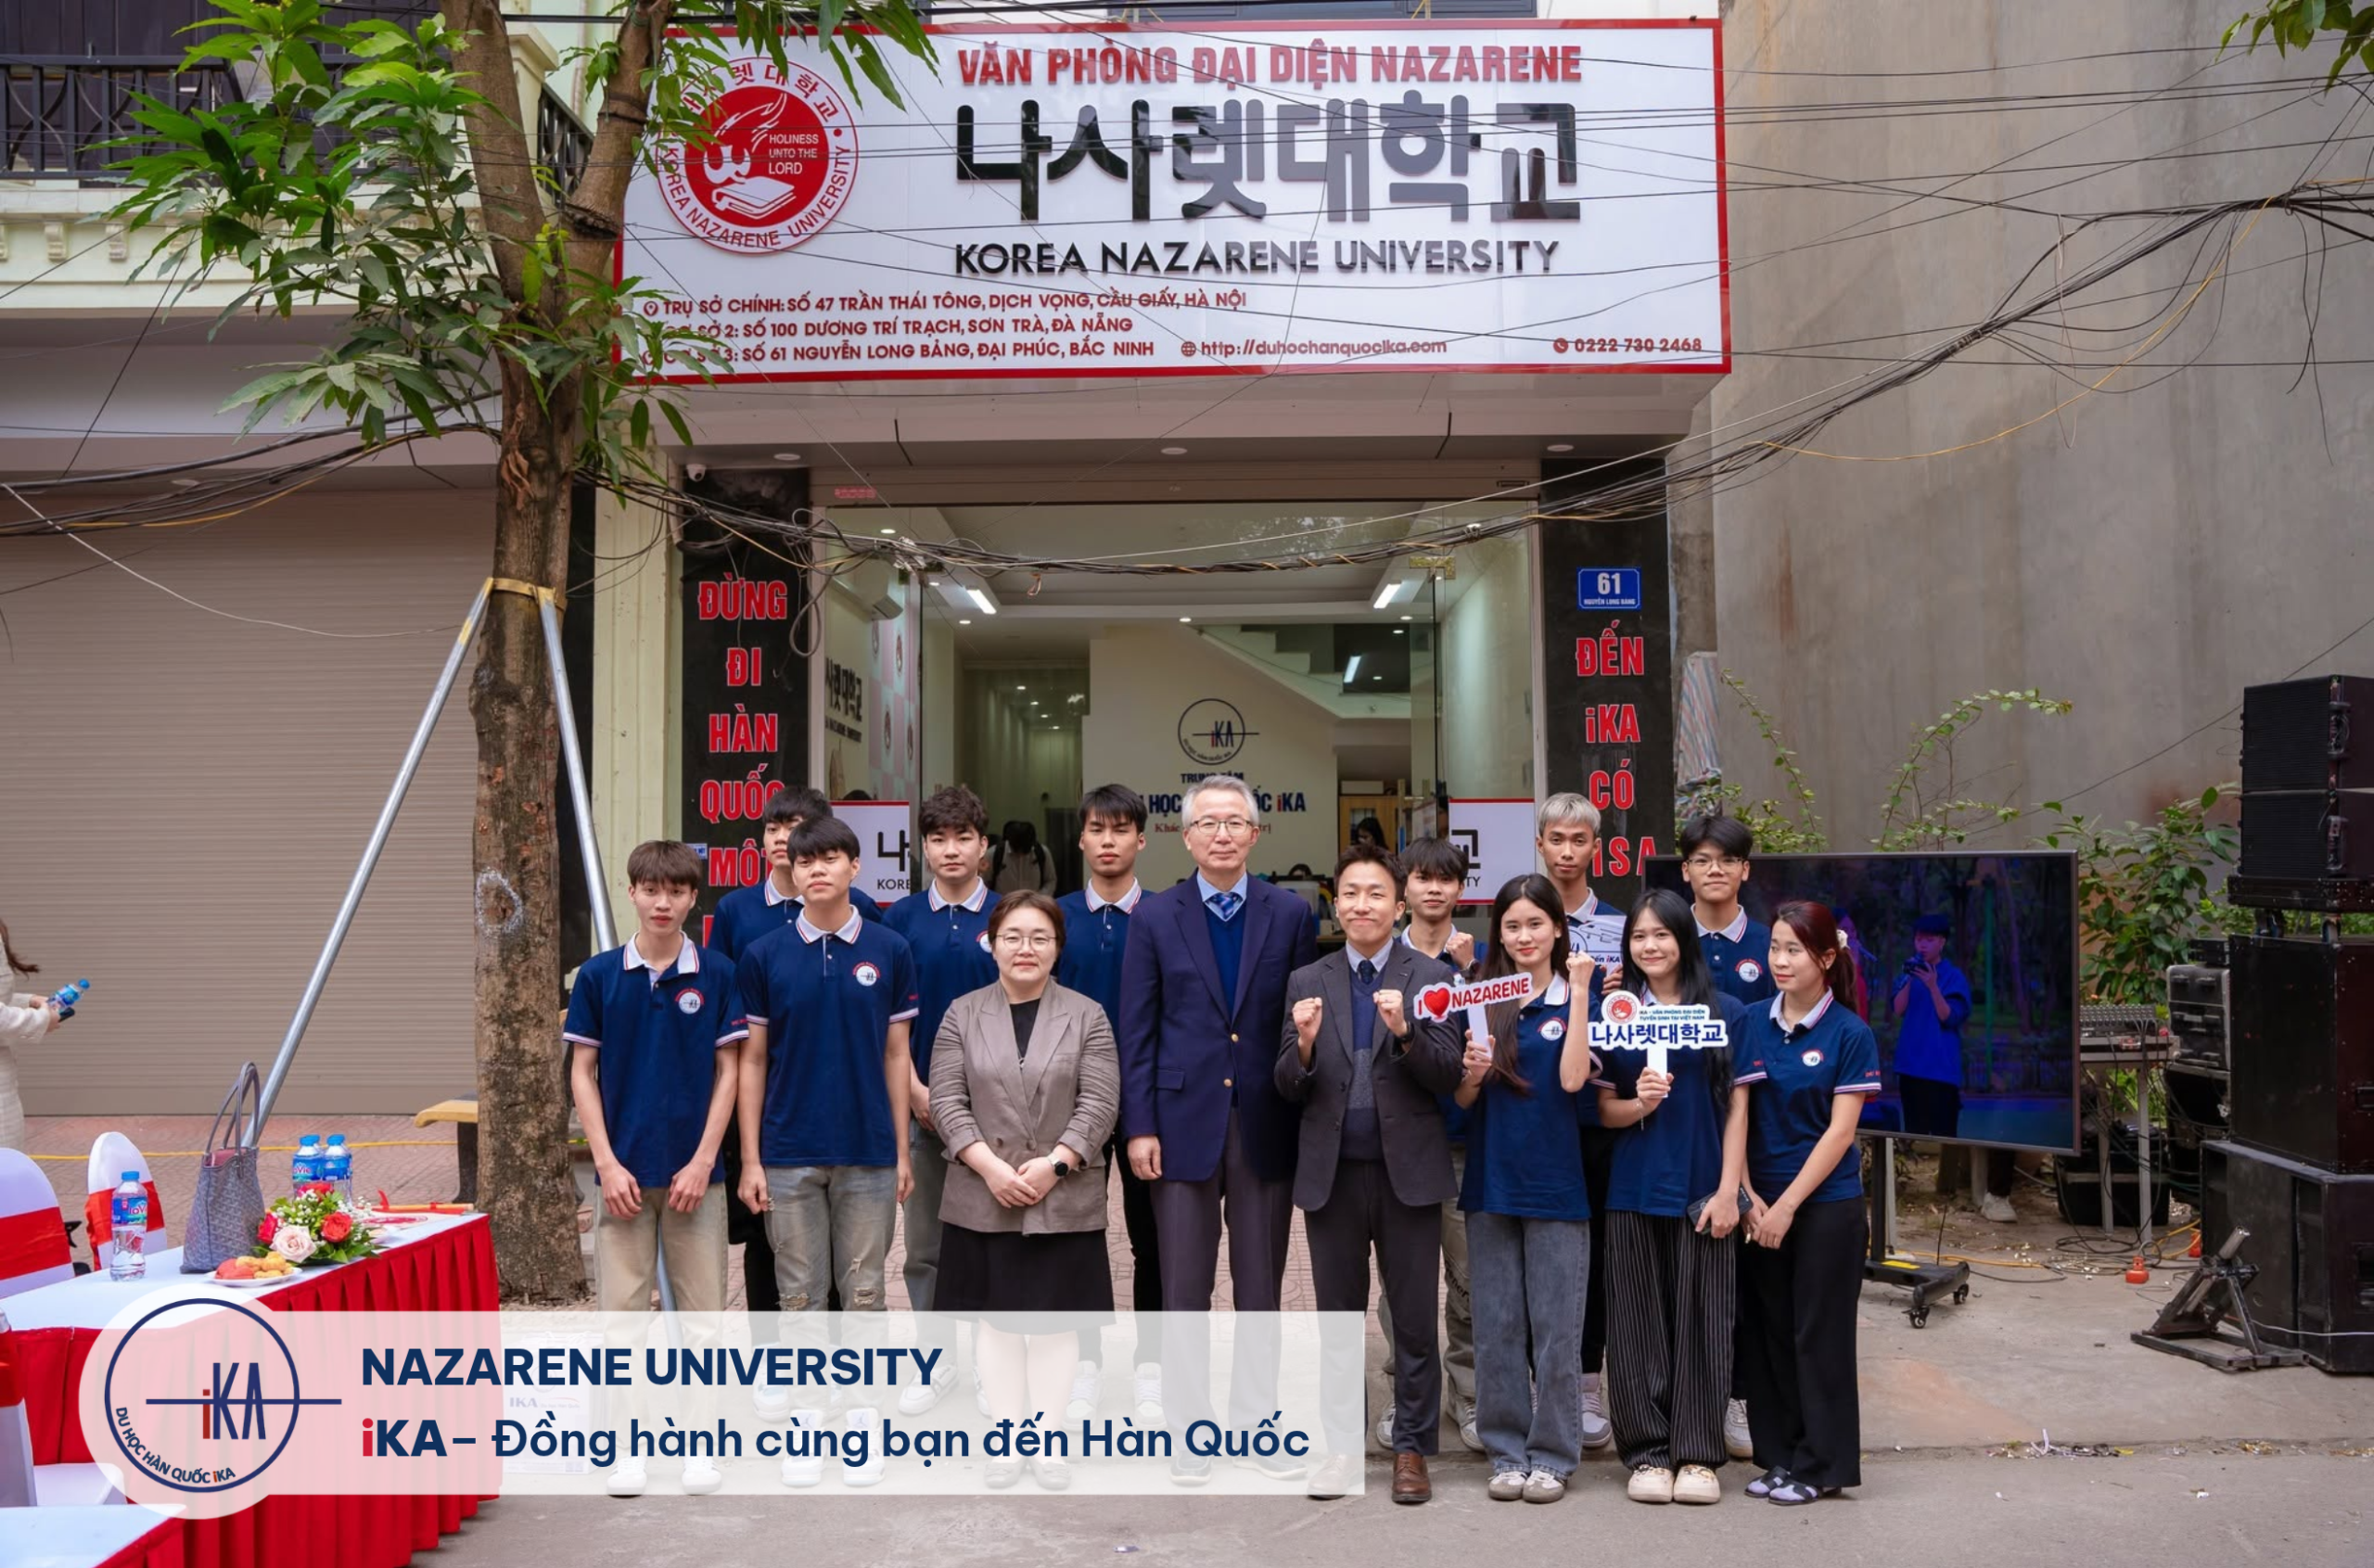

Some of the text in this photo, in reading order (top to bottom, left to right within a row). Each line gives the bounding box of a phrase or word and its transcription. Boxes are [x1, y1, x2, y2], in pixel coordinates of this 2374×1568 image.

[957, 38, 1582, 90] VĂN PHÒNG ĐẠI DIỆN NAZARENE
[769, 134, 819, 144] HOLINESS
[769, 147, 818, 159] UNTO THE
[768, 161, 803, 175] LORD
[956, 89, 1581, 222] 나사렛대학교
[685, 207, 781, 248] NAZARENE
[787, 146, 851, 238] UNIVERSITY
[954, 240, 1559, 274] KOREA NAZARENE UNIVERSITY
[663, 286, 1247, 318] TRỤ SỞ CHÍNH: SỐ 47 TRẦN THÁI TÔNG, DỊCH VỌNG, CẦU GIẤY, HÀ NỘI
[743, 317, 767, 338] SỐ
[771, 323, 798, 338] 100
[804, 320, 868, 337] DƯƠNG
[873, 315, 898, 336] TRÍ
[902, 319, 964, 338] TRẠCH,
[968, 318, 1004, 334] SƠN
[1012, 313, 1049, 335] TRÀ,
[1051, 313, 1076, 332] ĐÀ
[742, 341, 767, 362] SỐ
[770, 347, 787, 362] 61
[793, 339, 862, 361] NGUYỄN
[867, 343, 915, 360] LONG
[920, 338, 974, 360] BẢNG,
[977, 342, 1006, 361] ĐẠI
[1013, 338, 1065, 359] PHÚC,
[1069, 335, 1105, 356] BẮC
[1114, 341, 1155, 356] NINH
[1575, 338, 1703, 352] 0222 730 2468
[698, 571, 787, 620] ĐỪNG
[1598, 572, 1621, 594] 61
[1576, 619, 1645, 677] ĐẾN
[726, 647, 762, 686] ĐI
[708, 703, 778, 753] HÀN
[1211, 720, 1234, 748] iKA
[1586, 704, 1641, 744] iKA
[1589, 759, 1634, 810] CÓ
[1149, 794, 1182, 818] HỌC
[1276, 792, 1307, 812] iKA
[877, 830, 910, 873] 나
[1452, 977, 1530, 1009] NAZARENE
[1592, 1023, 1724, 1045] 나사렛대학교
